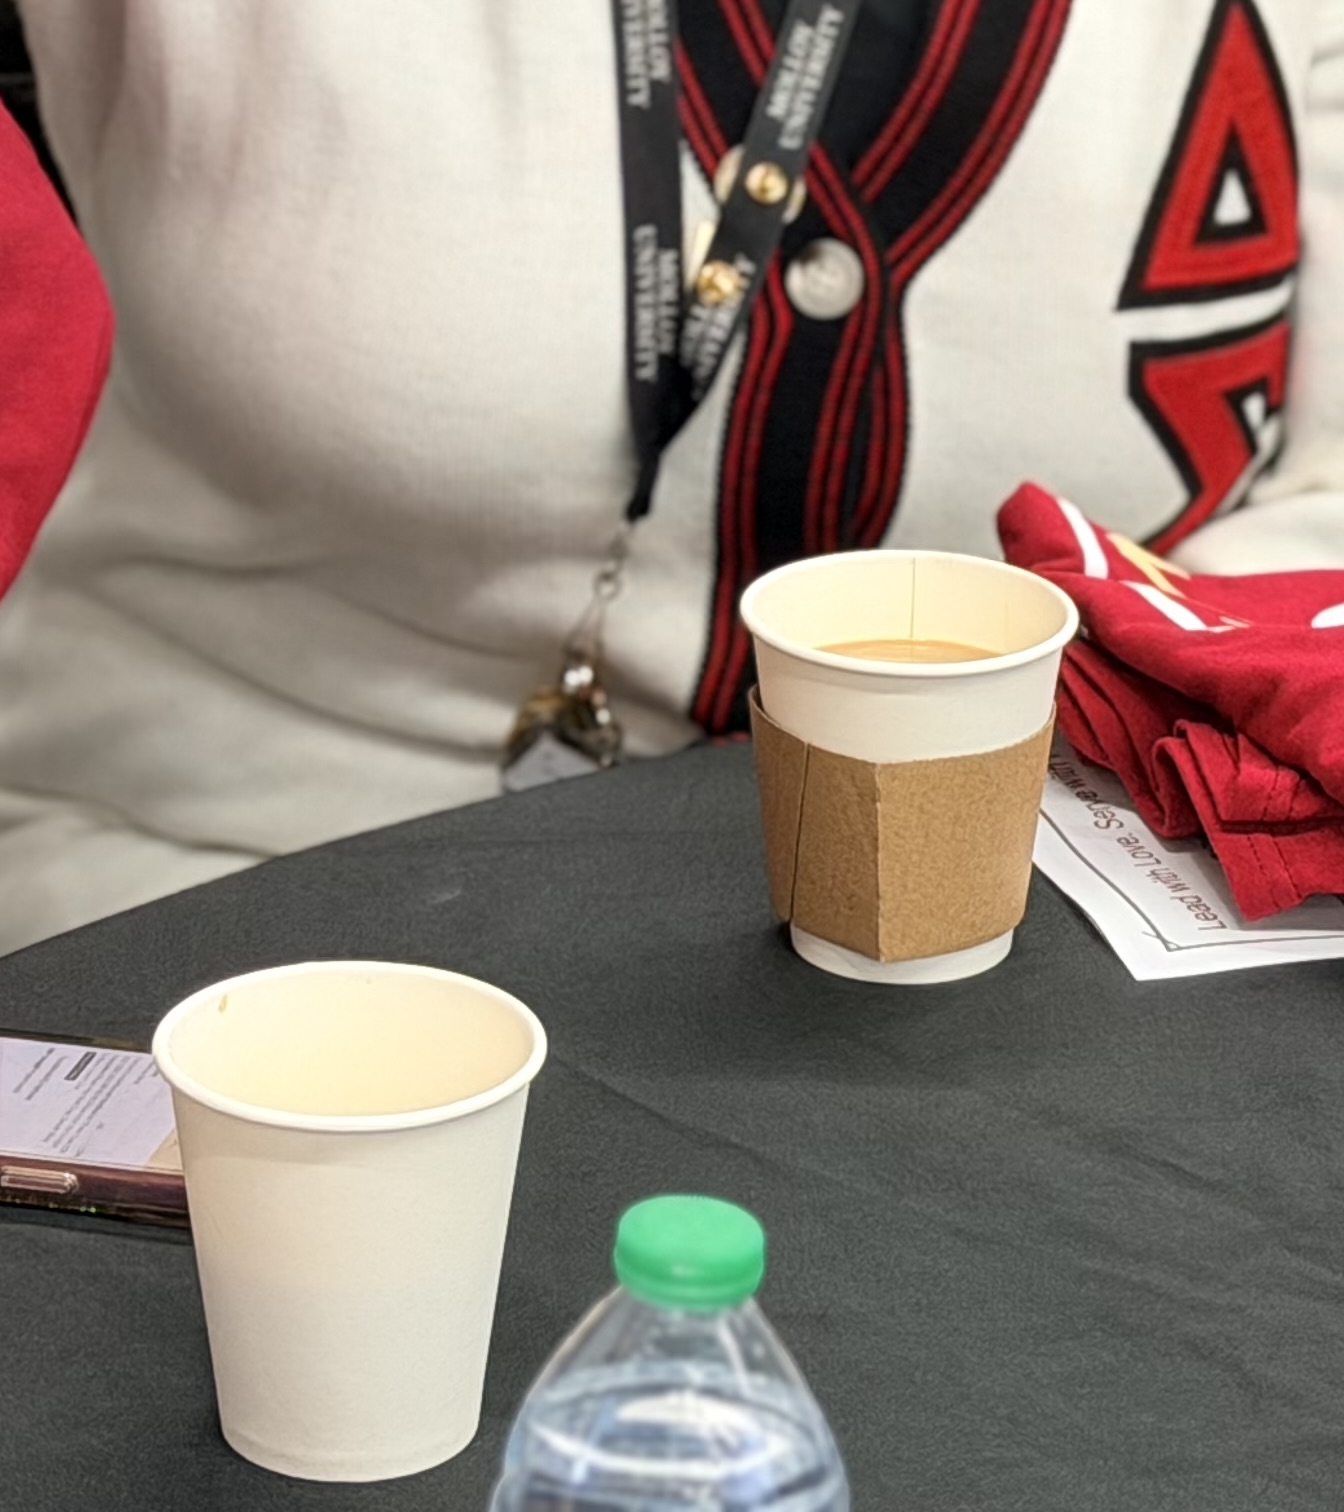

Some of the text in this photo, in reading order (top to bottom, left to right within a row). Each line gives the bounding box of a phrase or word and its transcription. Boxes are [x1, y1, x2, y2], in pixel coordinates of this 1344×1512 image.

[766, 19, 817, 122] MOLLOY
[778, 2, 846, 151] UNIVERSITY
[1074, 788, 1124, 830] Serve
[1116, 831, 1162, 868] Love.
[1145, 867, 1192, 894] with
[1170, 893, 1228, 931] Lead
